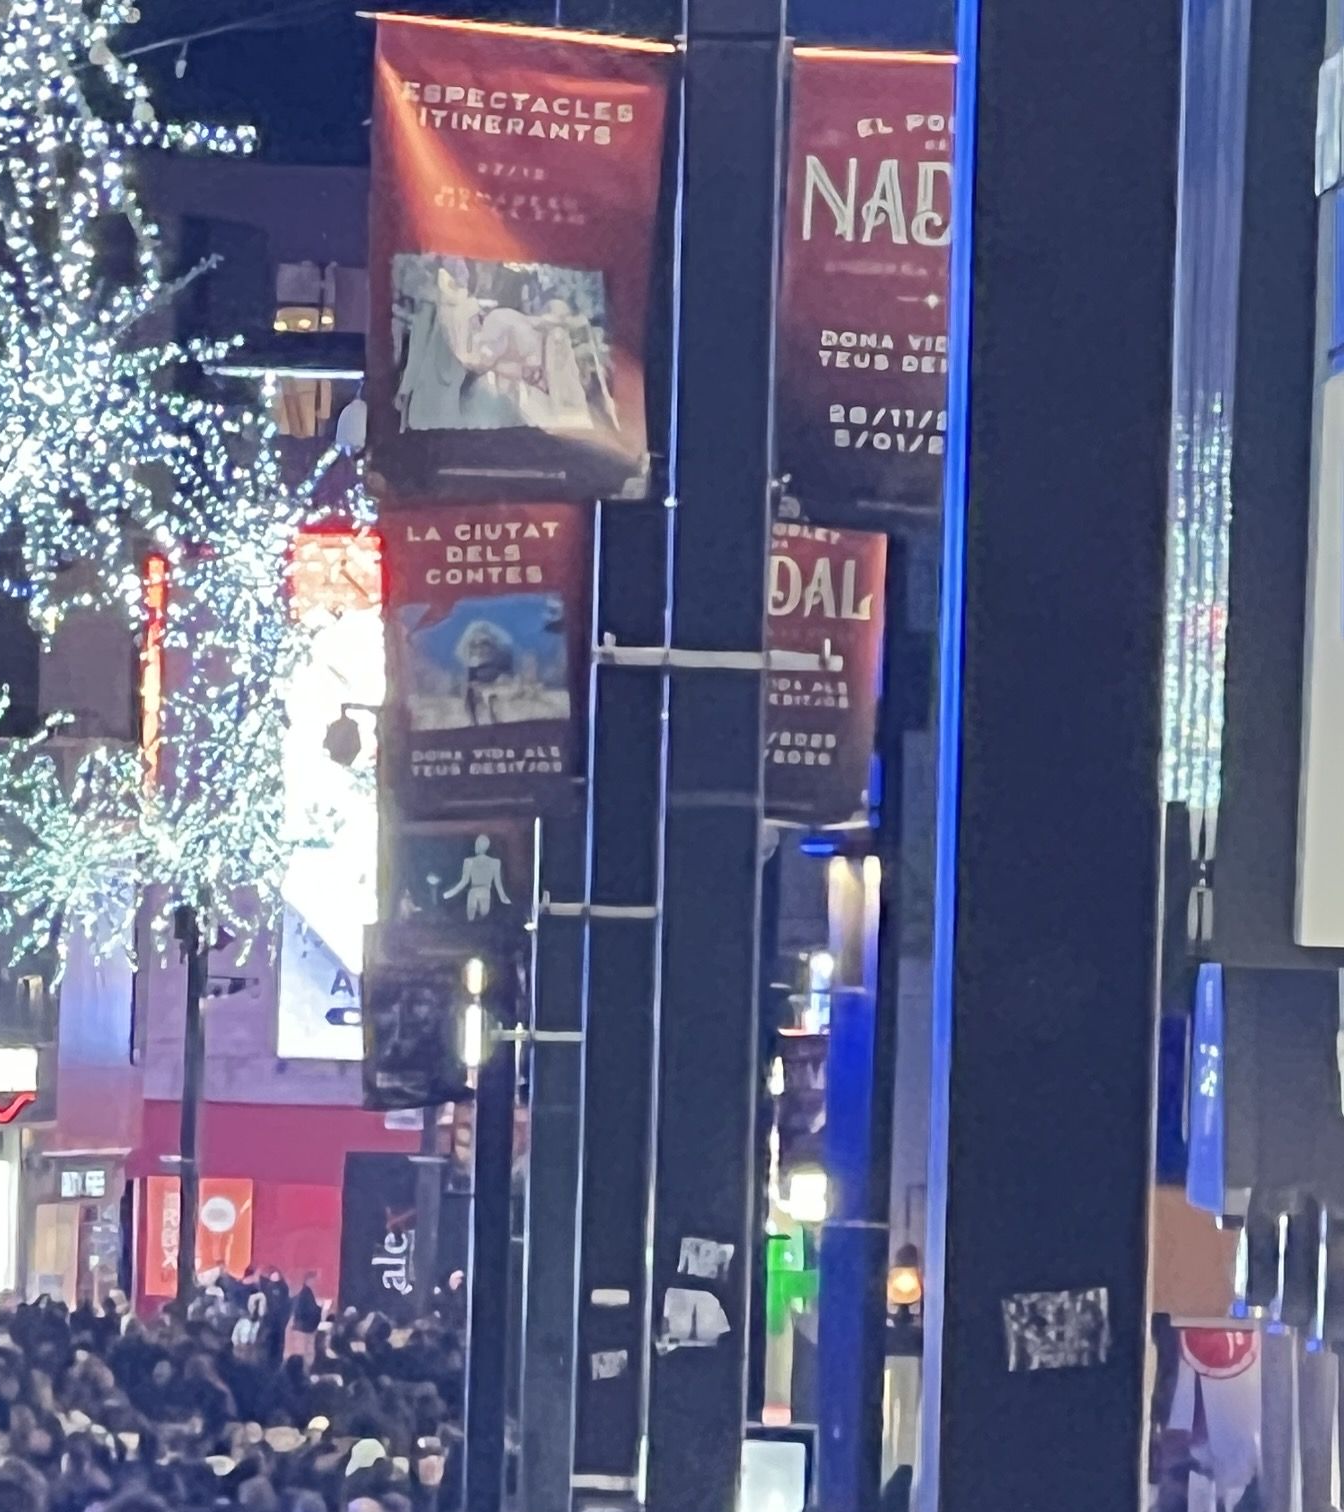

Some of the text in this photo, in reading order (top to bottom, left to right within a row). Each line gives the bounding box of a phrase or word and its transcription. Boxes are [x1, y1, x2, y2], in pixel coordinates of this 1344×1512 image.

[403, 81, 634, 123] ESPECTACLES
[419, 106, 611, 145] ITINERANTS
[857, 114, 955, 138] EL PO
[821, 330, 894, 349] DONA
[407, 521, 559, 542] LA CIUTAT
[446, 544, 521, 563] DELS
[425, 565, 543, 585] CONTES
